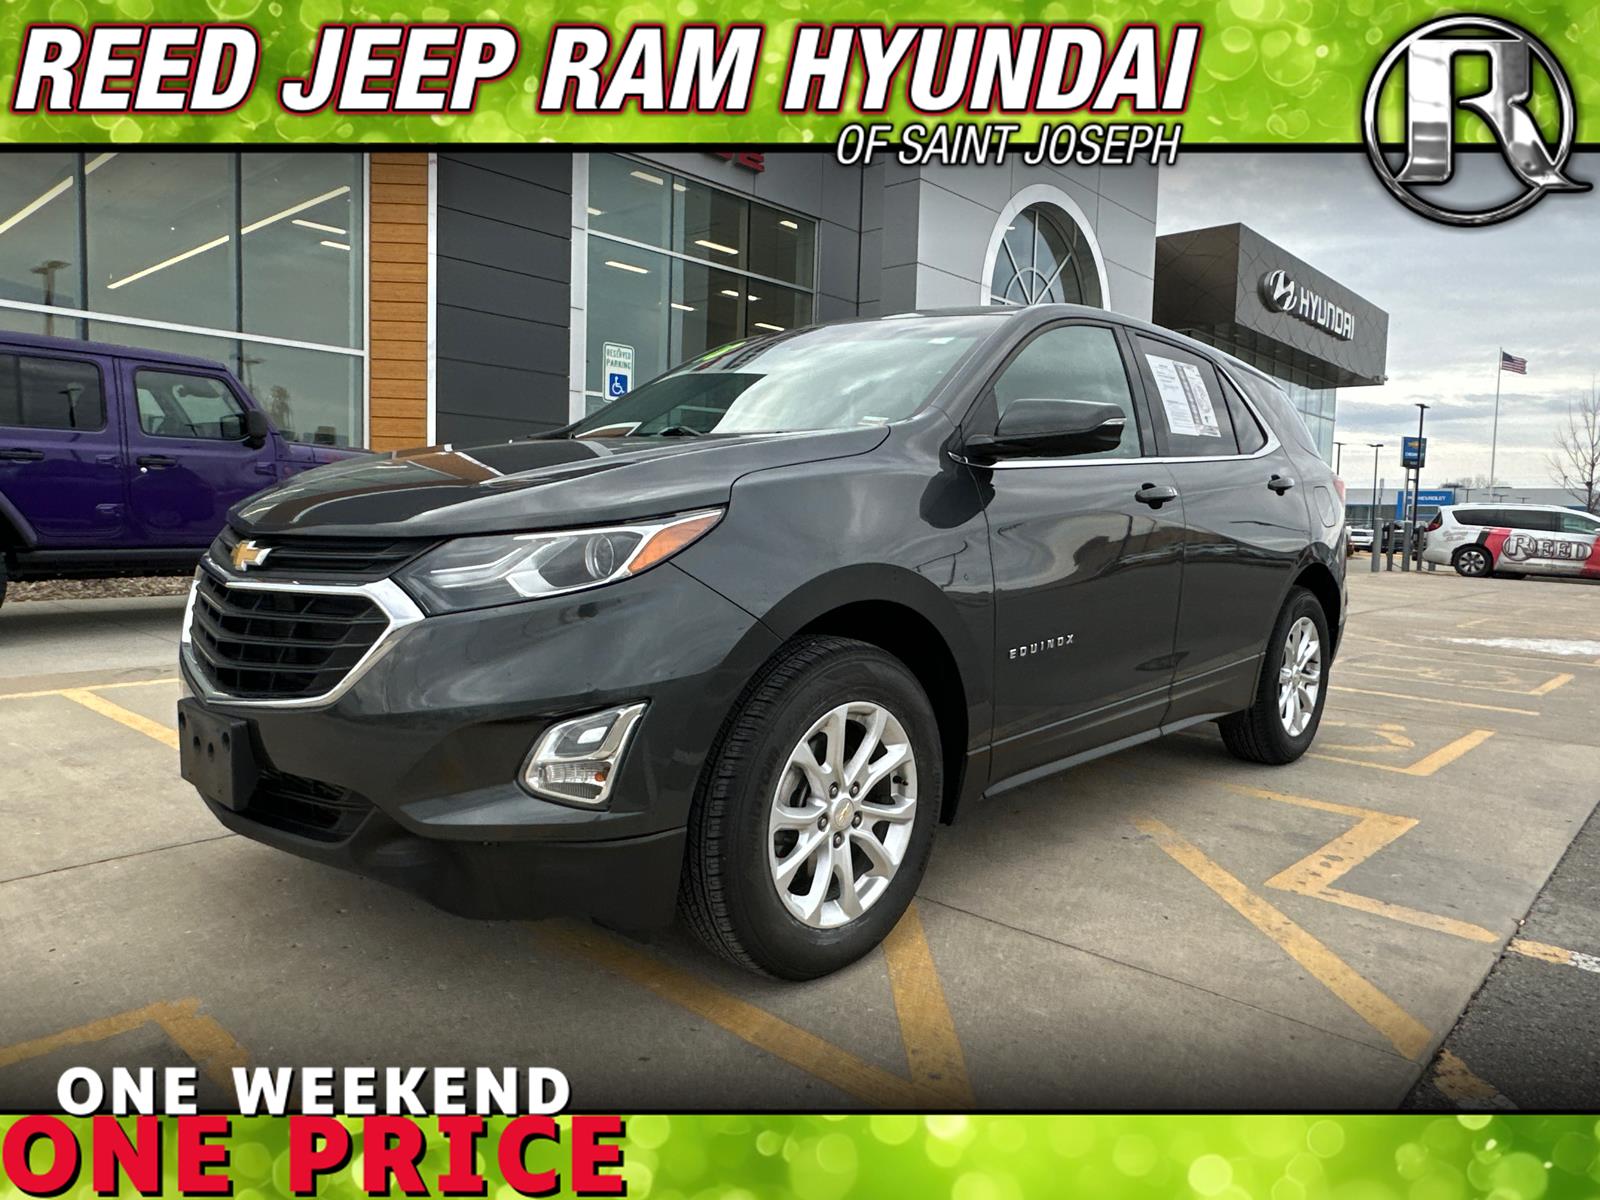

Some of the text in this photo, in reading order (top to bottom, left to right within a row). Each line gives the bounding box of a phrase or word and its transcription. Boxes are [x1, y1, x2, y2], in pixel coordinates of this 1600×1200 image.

[1299, 286, 1355, 340] HYUNDAI
[606, 348, 631, 360] RESERVED
[606, 359, 631, 370] PARKING
[1507, 534, 1592, 560] REED
[1009, 634, 1074, 659] EQUINOX
